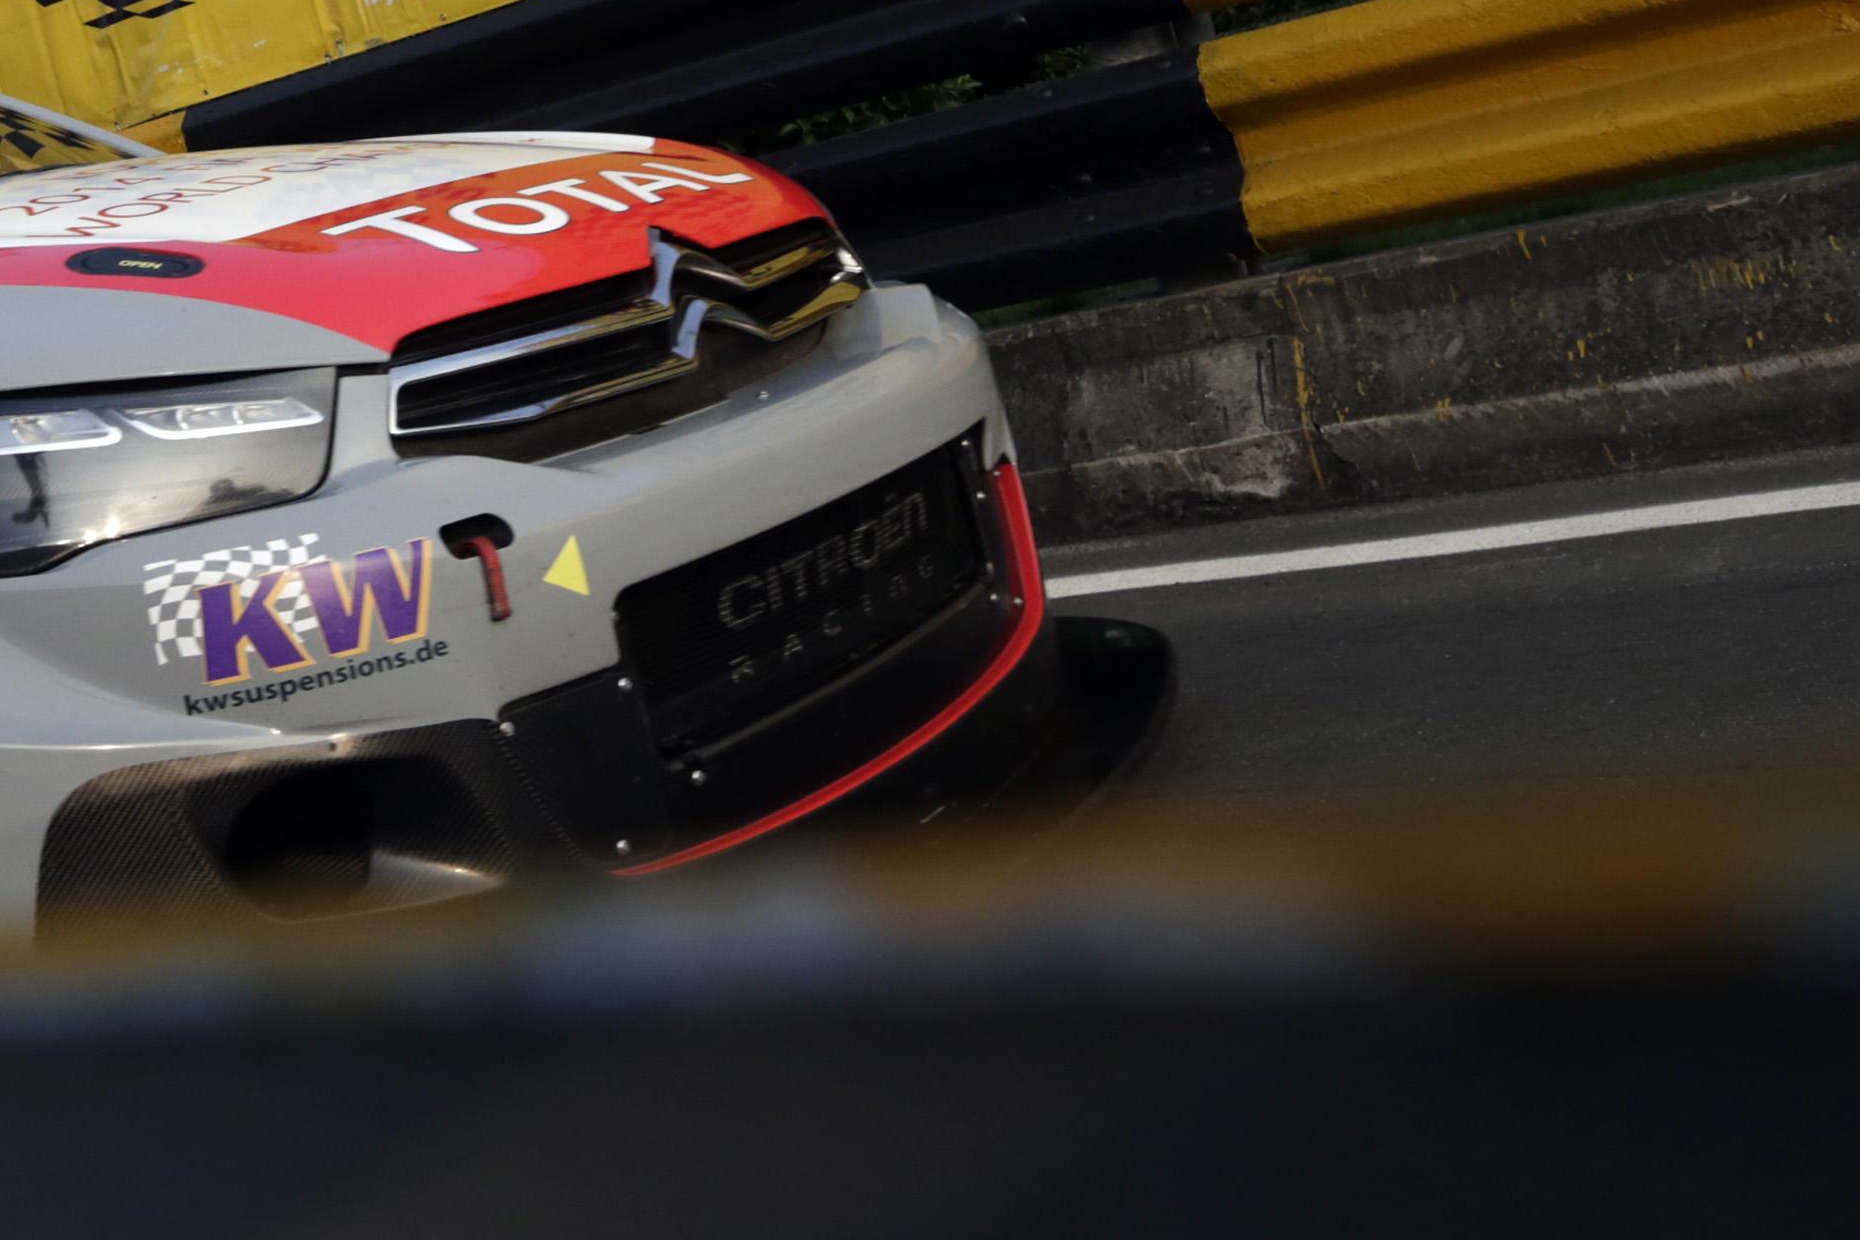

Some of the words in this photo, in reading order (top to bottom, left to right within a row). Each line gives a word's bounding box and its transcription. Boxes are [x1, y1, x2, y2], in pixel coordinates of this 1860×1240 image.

[26, 175, 271, 237] WORLD
[320, 162, 753, 253] TOTAL
[194, 537, 433, 687] KW
[183, 639, 449, 716] kwsuspensions.de
